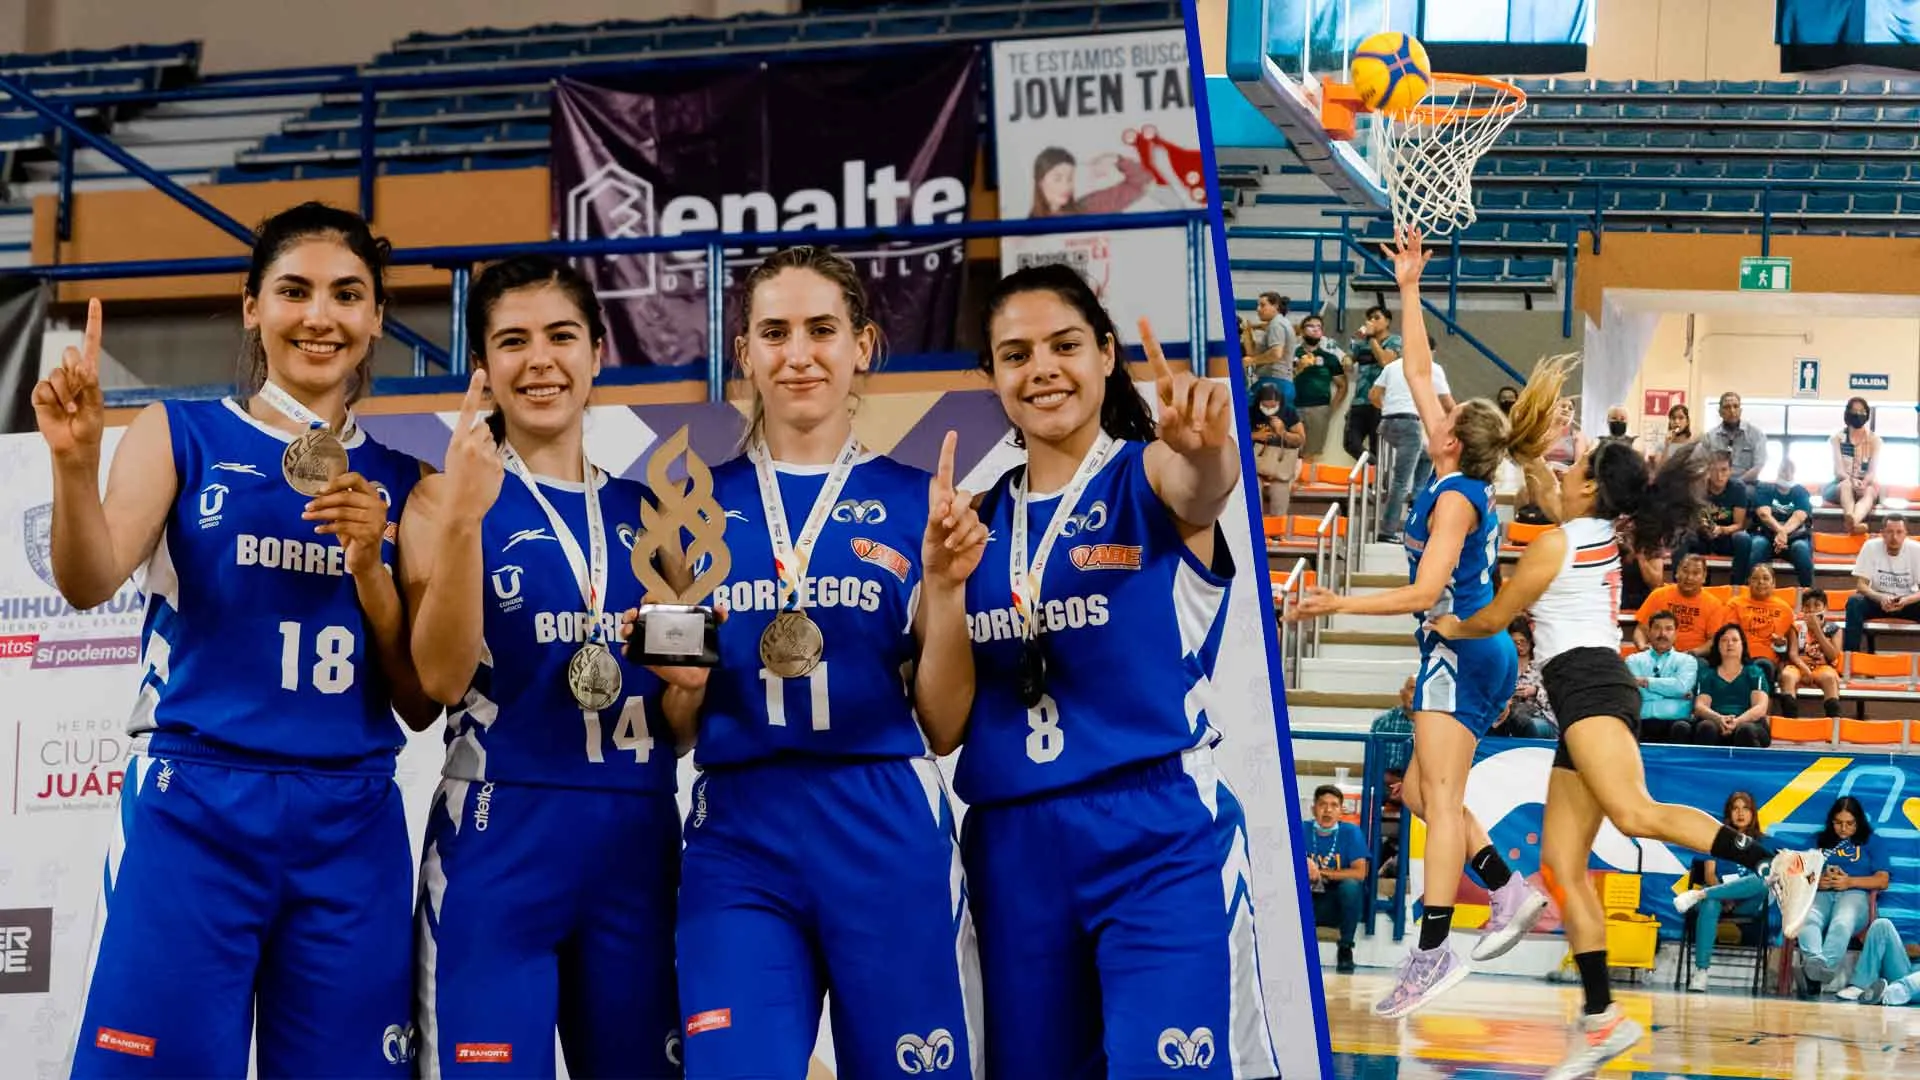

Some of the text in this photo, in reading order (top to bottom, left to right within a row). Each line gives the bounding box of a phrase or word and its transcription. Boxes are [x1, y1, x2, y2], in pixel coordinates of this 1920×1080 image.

[1009, 41, 1188, 75] TE ESTAMOS BUSC
[1009, 67, 1195, 122] JOVEN TA
[661, 246, 965, 292] DESLLOS
[1851, 377, 1888, 387] SALIDA
[236, 533, 353, 577] BORRE
[56, 644, 138, 665] podemos
[279, 620, 356, 695] 18
[759, 661, 831, 731] 11
[579, 695, 655, 764] 14
[1026, 694, 1064, 765] 8
[109, 1036, 151, 1052] BANORTE
